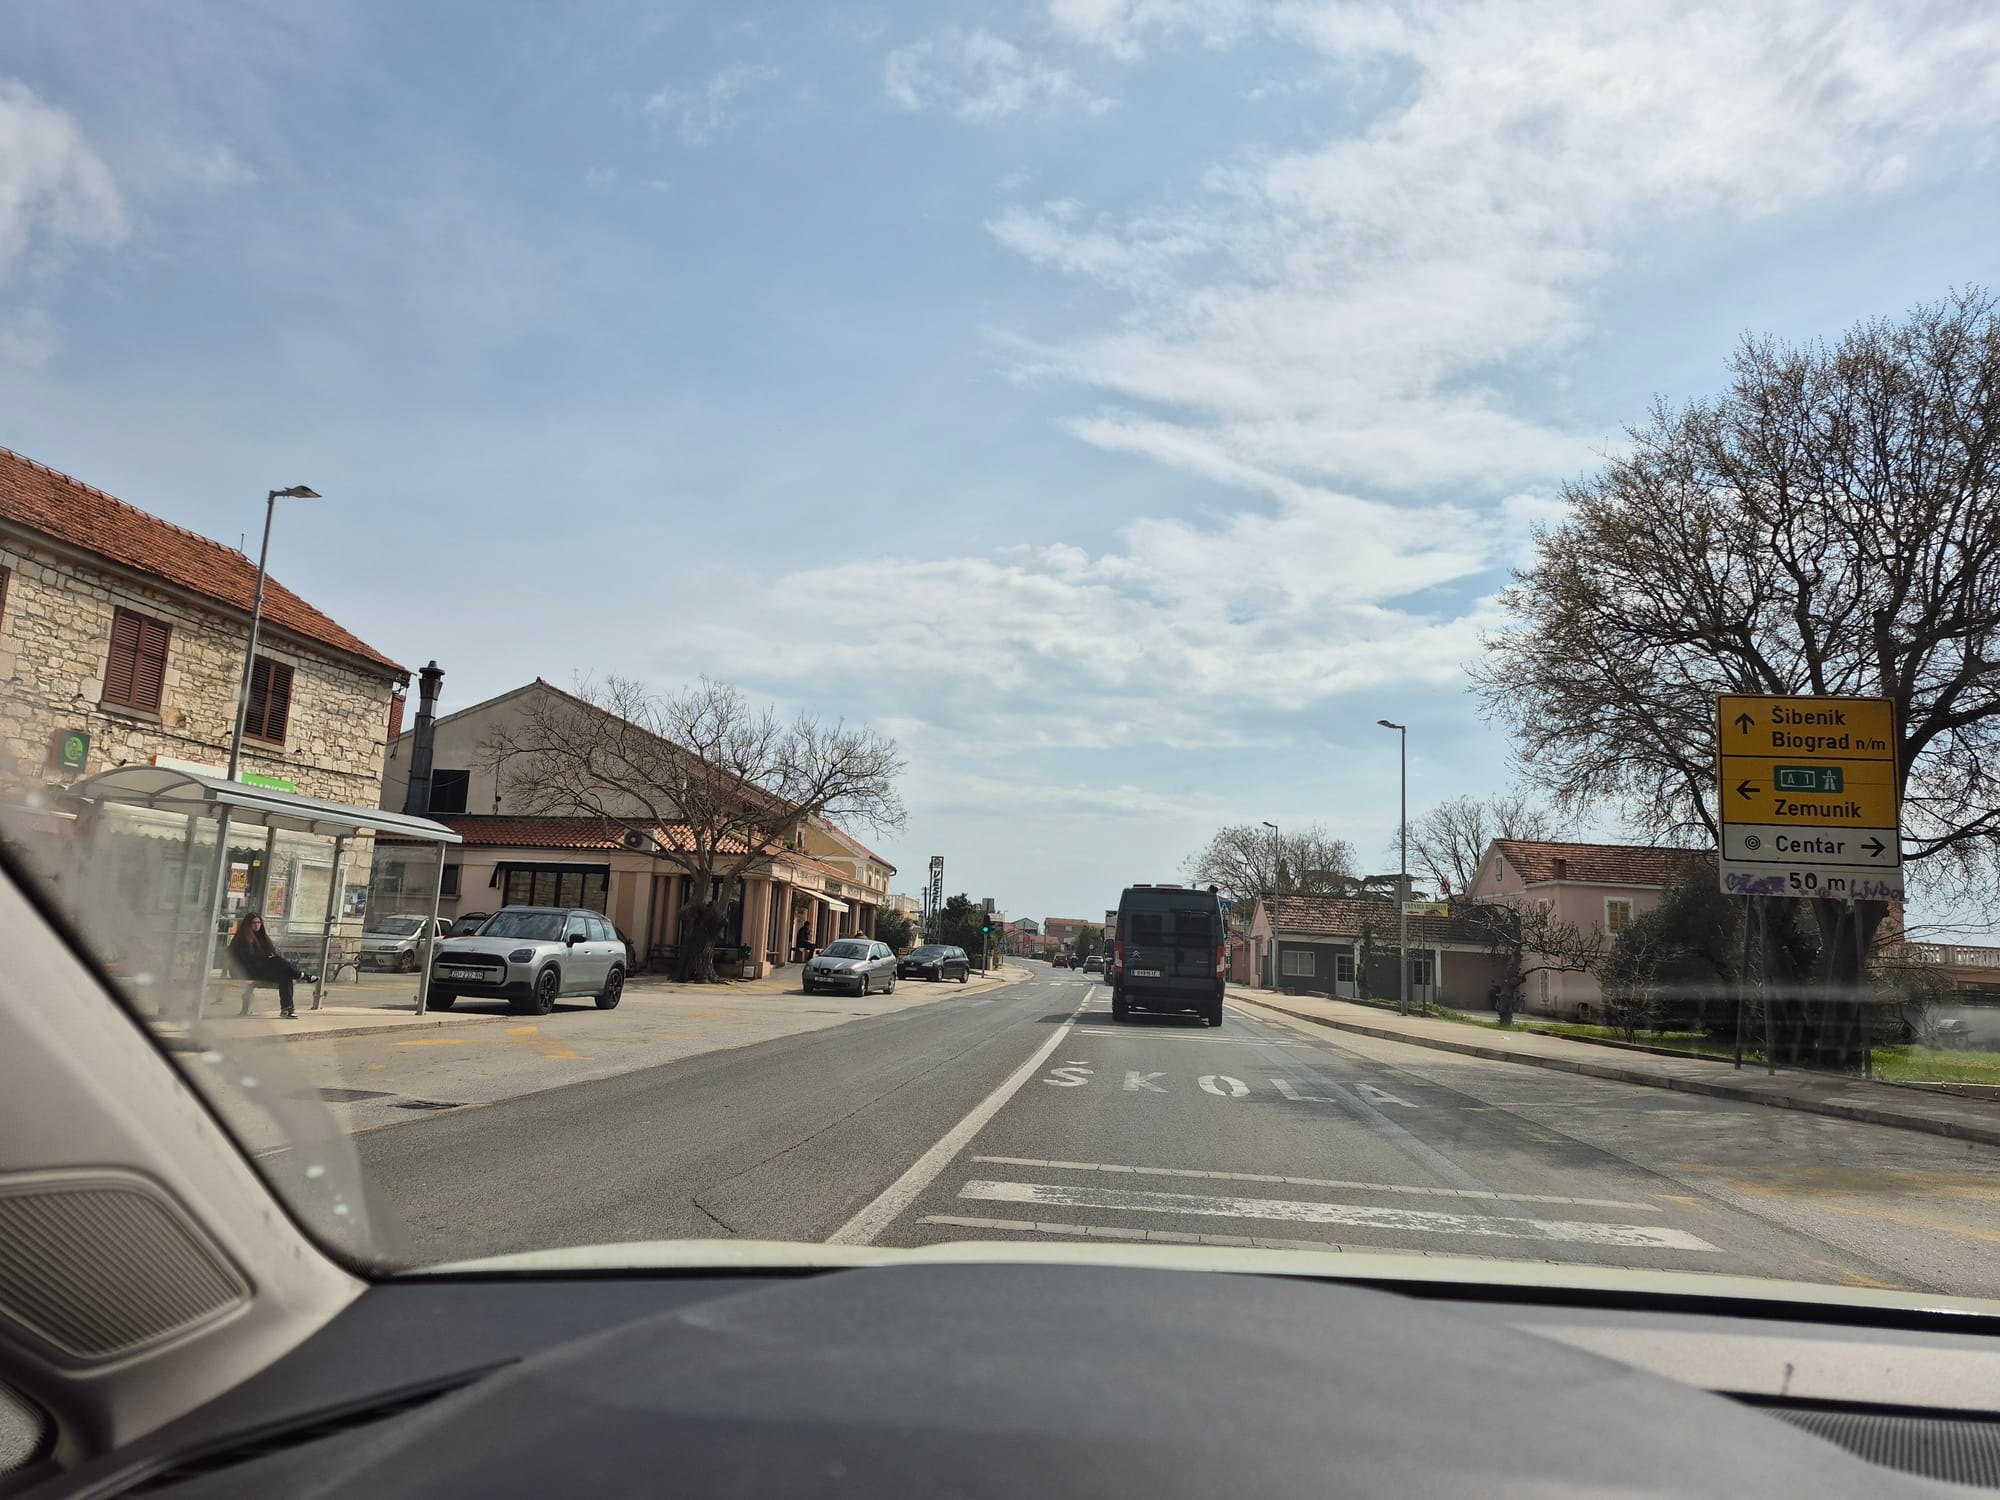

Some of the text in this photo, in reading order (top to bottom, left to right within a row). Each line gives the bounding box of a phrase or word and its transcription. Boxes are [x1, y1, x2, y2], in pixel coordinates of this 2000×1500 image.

[1772, 705, 1846, 726] Šibenik
[1772, 731, 1886, 752] Biograd n/m
[1775, 799, 1861, 818] Zemunik
[1776, 835, 1845, 854] Centar
[1789, 872, 1817, 890] 50
[1828, 877, 1845, 891] m
[1043, 1061, 1420, 1108] ŠKOLA
